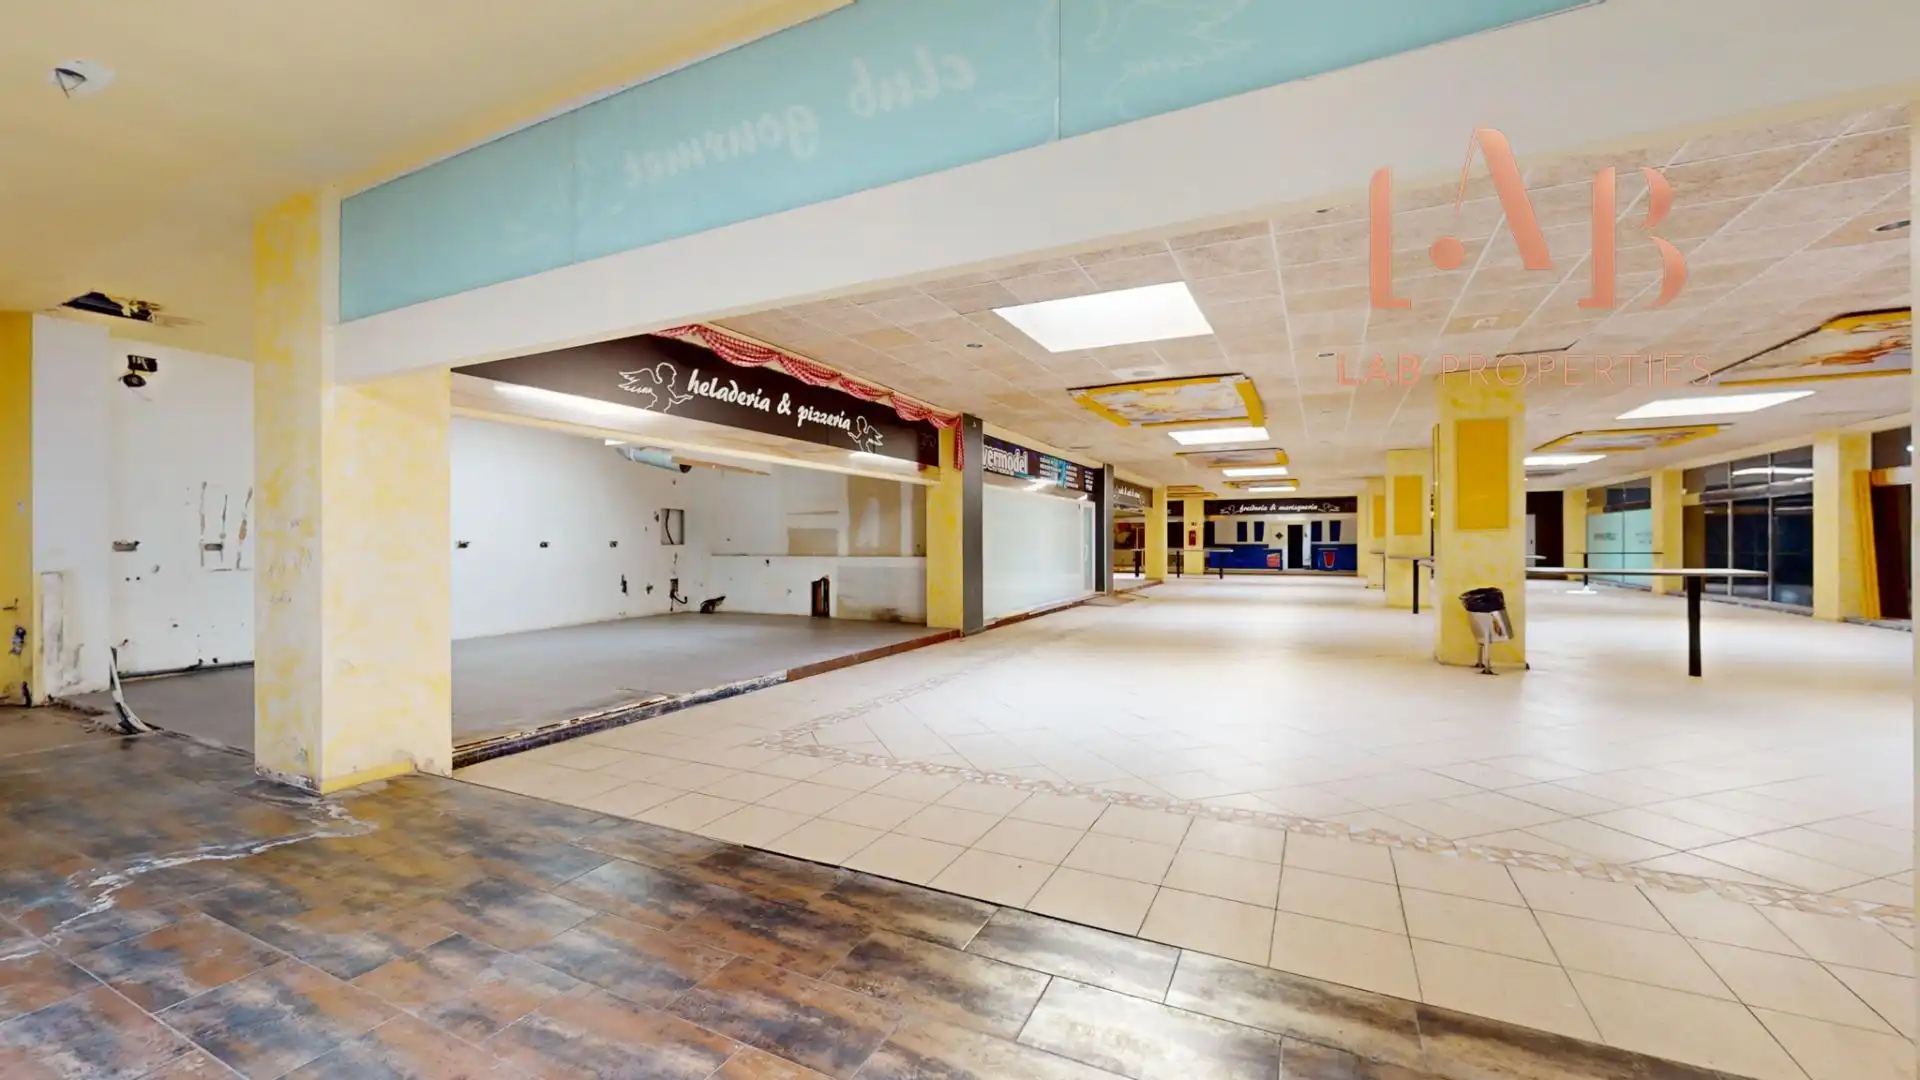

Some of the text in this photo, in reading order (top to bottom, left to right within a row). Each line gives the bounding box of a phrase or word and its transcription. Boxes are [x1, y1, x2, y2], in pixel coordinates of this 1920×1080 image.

[687, 368, 852, 431] heladeria & pizzeria
